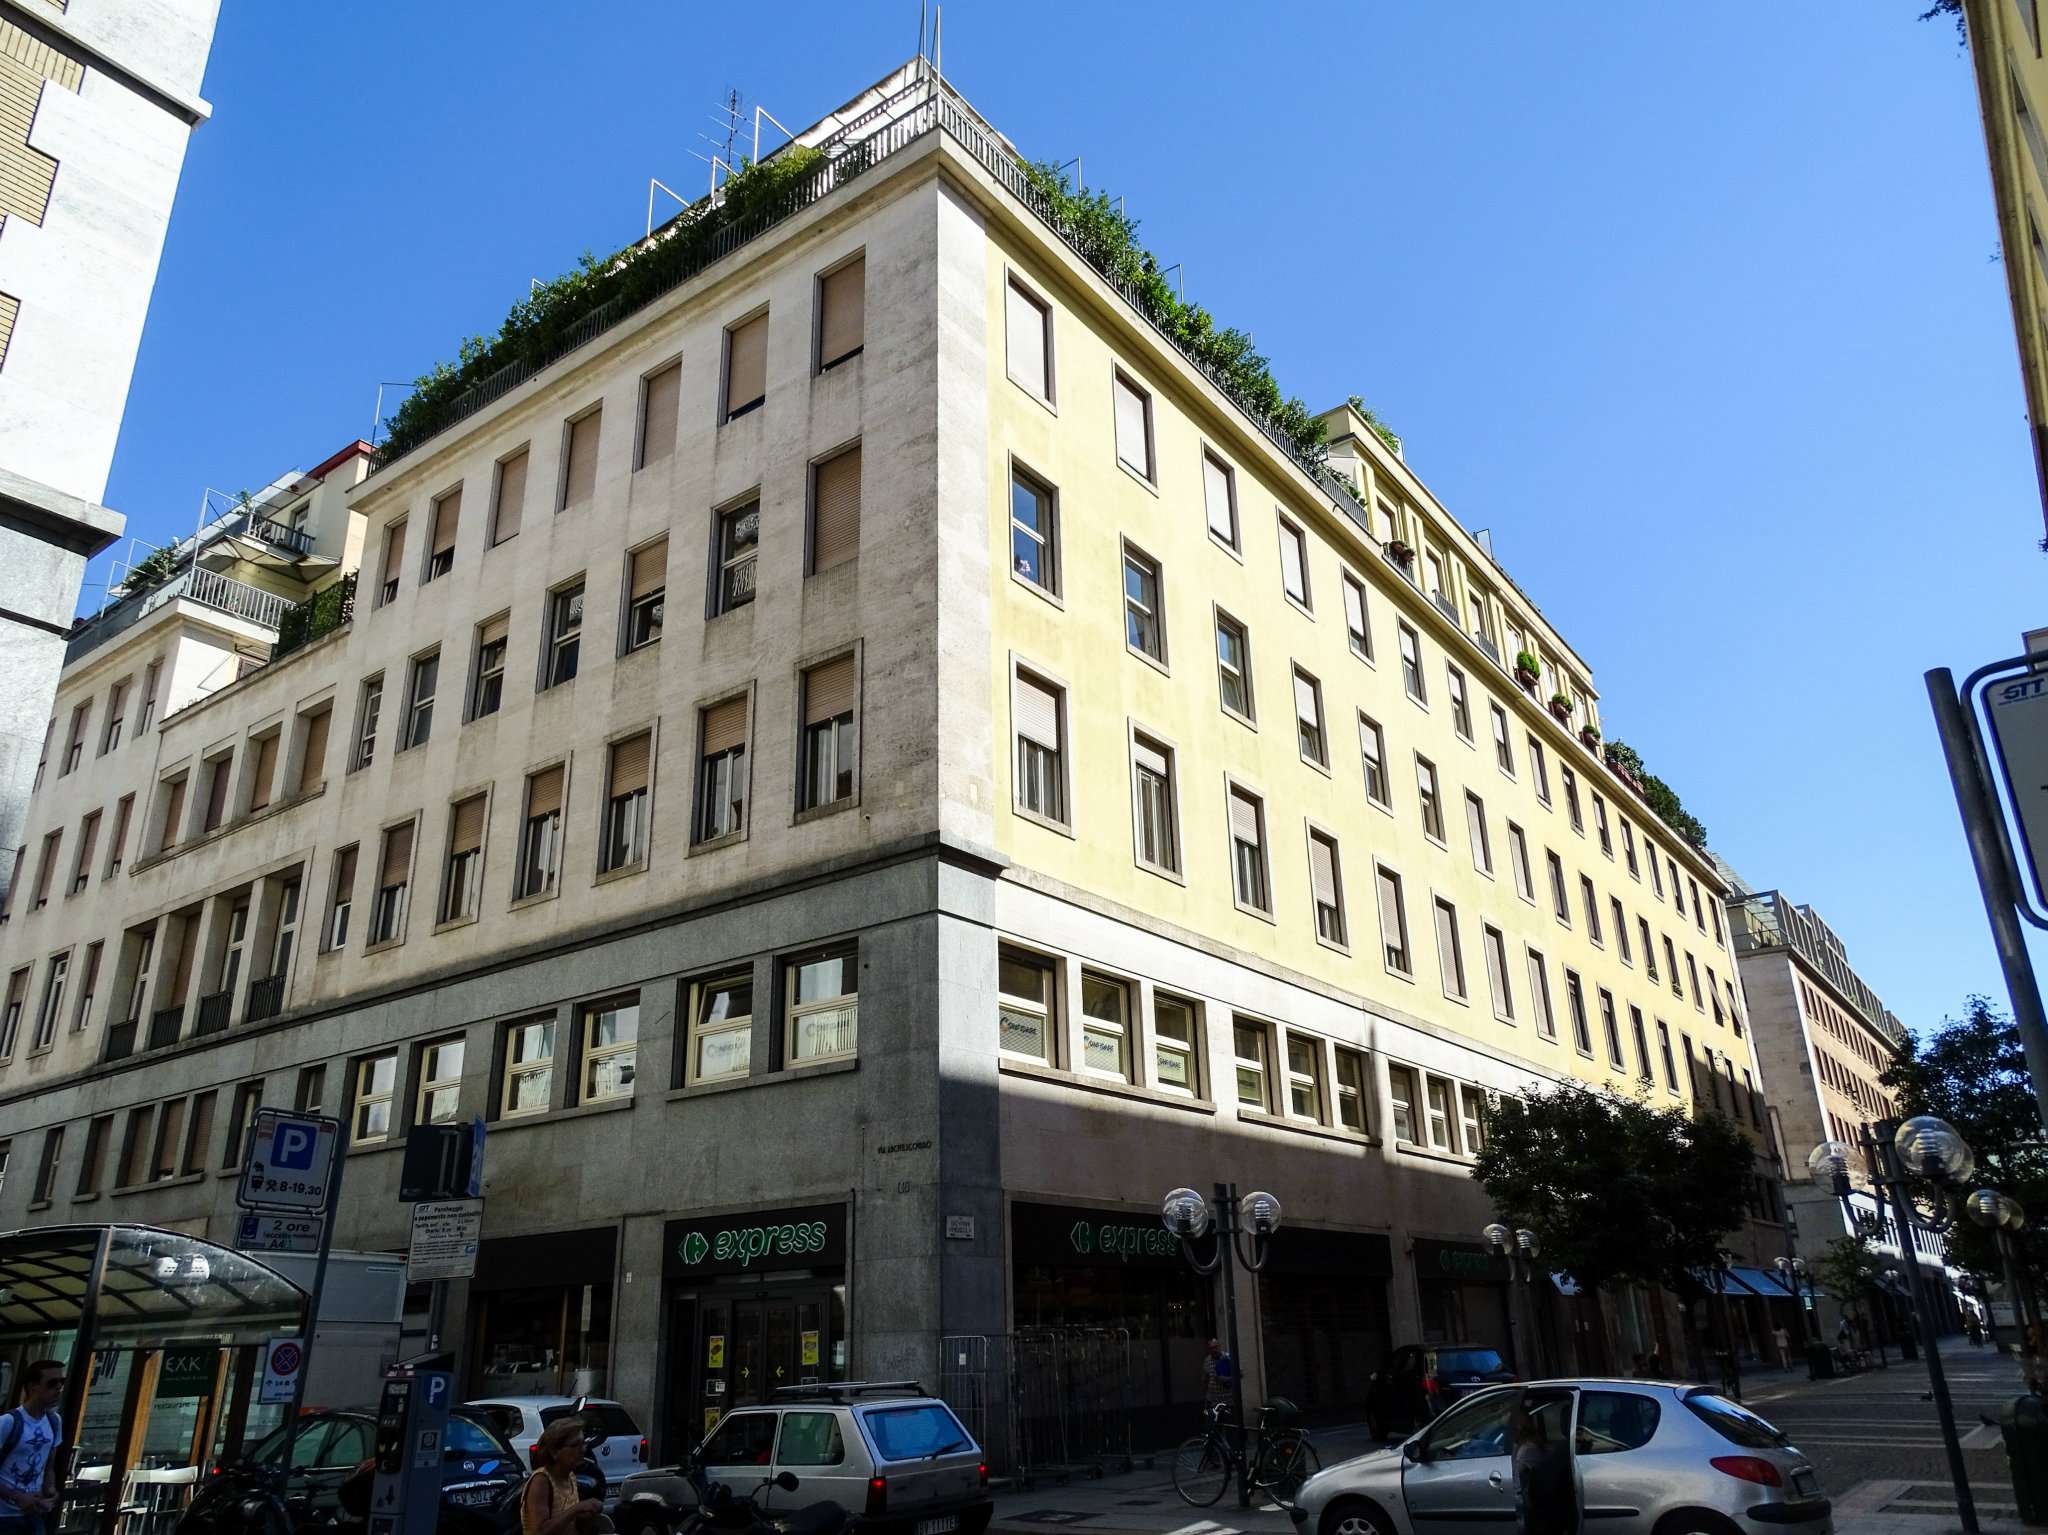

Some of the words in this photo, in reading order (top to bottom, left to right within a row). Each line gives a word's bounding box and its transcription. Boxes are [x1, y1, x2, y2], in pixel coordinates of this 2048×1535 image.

[280, 1128, 308, 1163] P
[273, 1220, 283, 1232] 2
[286, 1222, 316, 1233] ore
[713, 1221, 827, 1267] express
[1100, 1225, 1177, 1263] express
[428, 1376, 446, 1405] P
